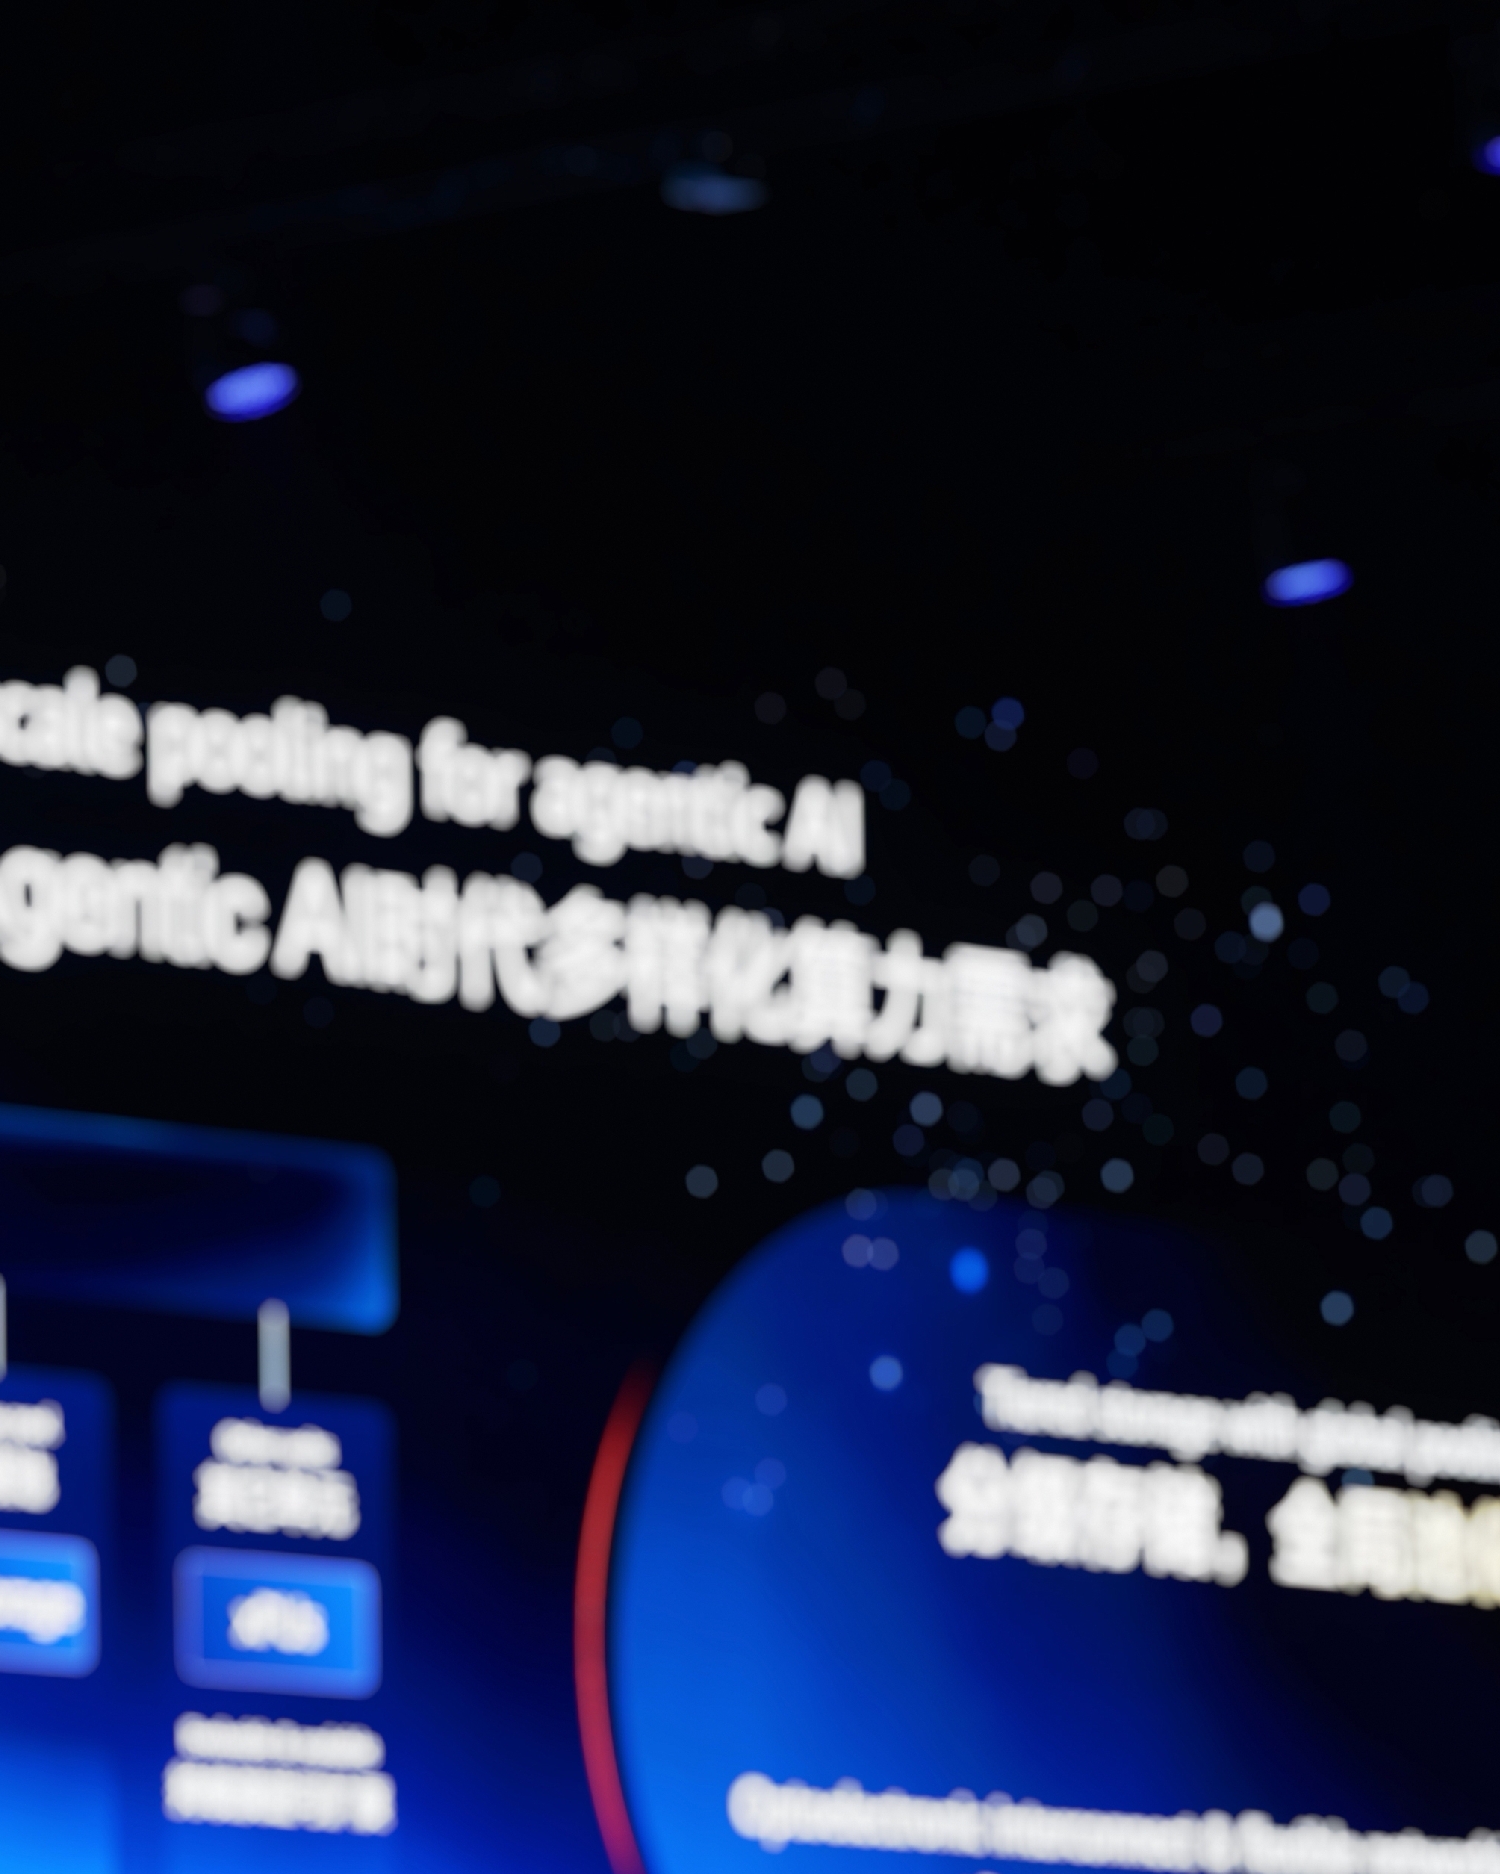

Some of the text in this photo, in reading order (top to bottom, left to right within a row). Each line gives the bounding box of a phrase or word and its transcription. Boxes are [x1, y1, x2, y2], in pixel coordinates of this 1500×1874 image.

[147, 698, 412, 835] pooling
[417, 718, 530, 827] for
[531, 757, 785, 866] agentic
[784, 778, 864, 875] AI
